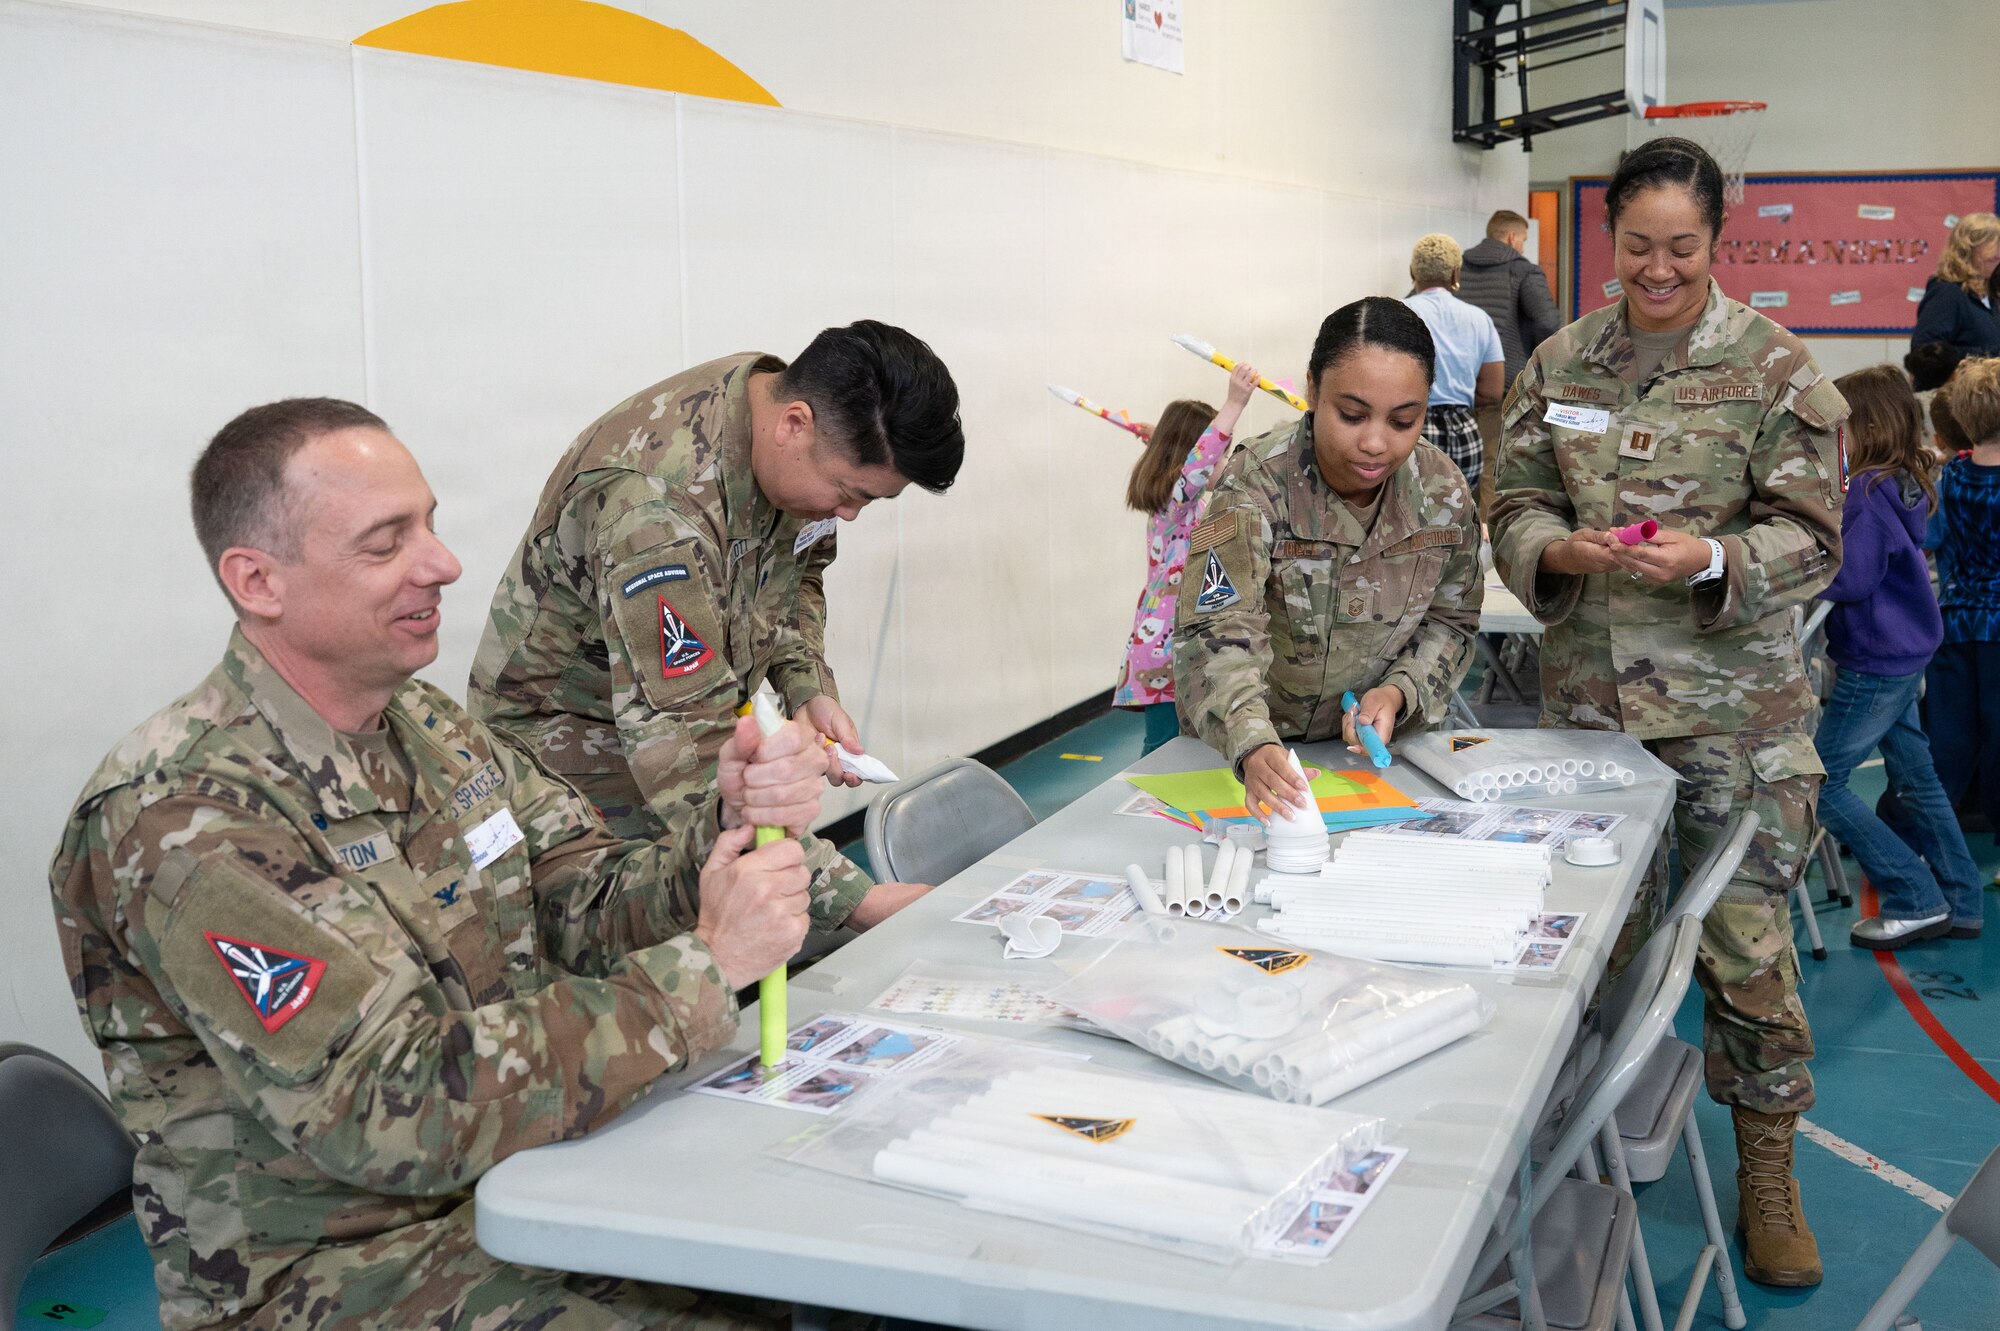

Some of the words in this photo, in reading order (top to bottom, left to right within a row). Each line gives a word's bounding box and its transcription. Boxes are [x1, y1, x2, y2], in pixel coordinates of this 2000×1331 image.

[1715, 239, 1929, 264] TSMANSHIP
[1561, 384, 1602, 400] DAWES
[1700, 386, 1719, 401] AIR
[1721, 384, 1759, 399] FORCE
[1559, 408, 1580, 416] VISITOR
[625, 577, 648, 593] REGIONAL
[647, 570, 664, 581] SPACE
[664, 569, 687, 577] ADVISOR
[683, 661, 699, 672] JAPAN
[454, 774, 494, 810] SPACE
[340, 841, 378, 867] TON
